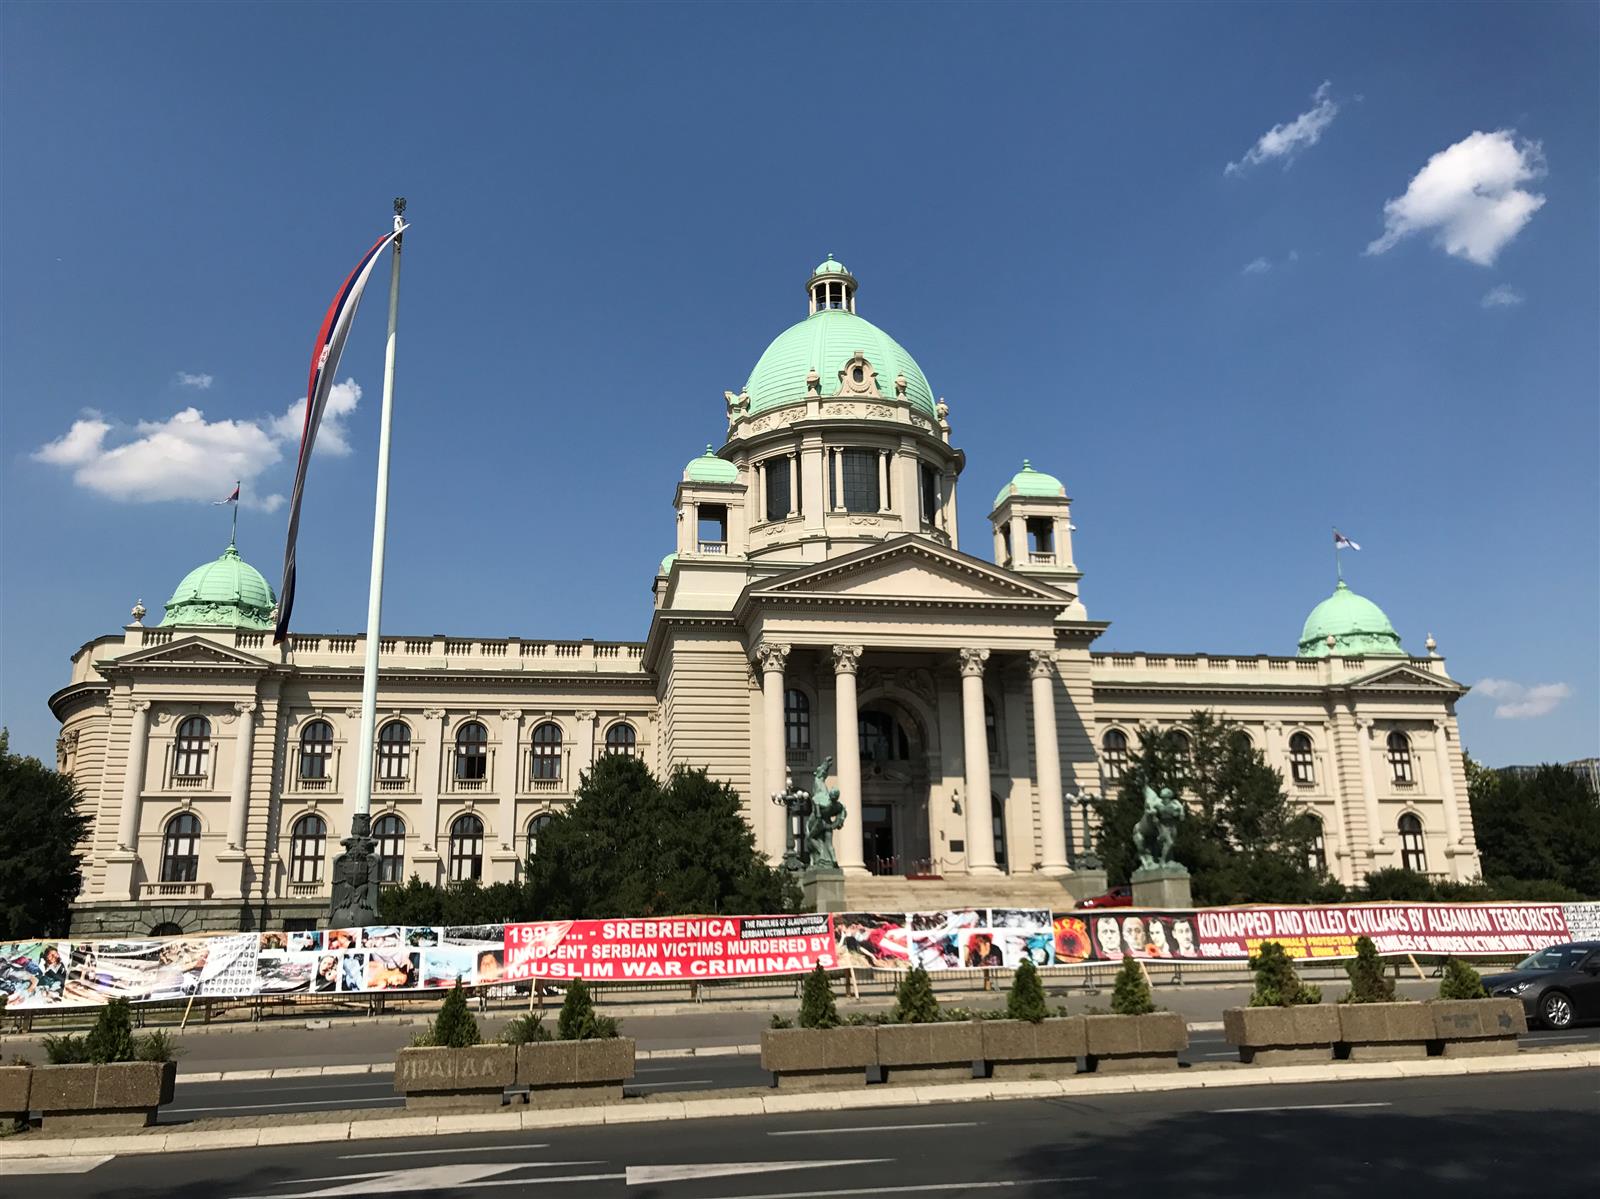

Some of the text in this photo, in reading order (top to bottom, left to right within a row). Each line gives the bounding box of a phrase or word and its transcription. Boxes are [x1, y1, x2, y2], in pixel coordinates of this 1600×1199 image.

[603, 919, 736, 939] SREBRENICA
[745, 920, 755, 929] THE
[756, 919, 779, 928] FAMILIES
[779, 918, 787, 927] OF
[1198, 907, 1565, 937] KIDNAPPED AND KILLED CIVILIANS BY ALBANIAN TERRORISTS
[741, 929, 765, 939] SERBIAN
[786, 927, 801, 936] WANT
[509, 937, 831, 962] INNOCENT SERBIAN VICTIMS MURDERED BY
[1371, 935, 1416, 953] FAMILIES
[1414, 935, 1428, 951] OF
[1426, 935, 1473, 952] MURDER
[1463, 935, 1507, 952] VICTIMS
[1500, 934, 1532, 951] WANT
[1529, 935, 1562, 951] JUSTICE
[508, 954, 833, 979] MUSLIM WAR CRIMINALS
